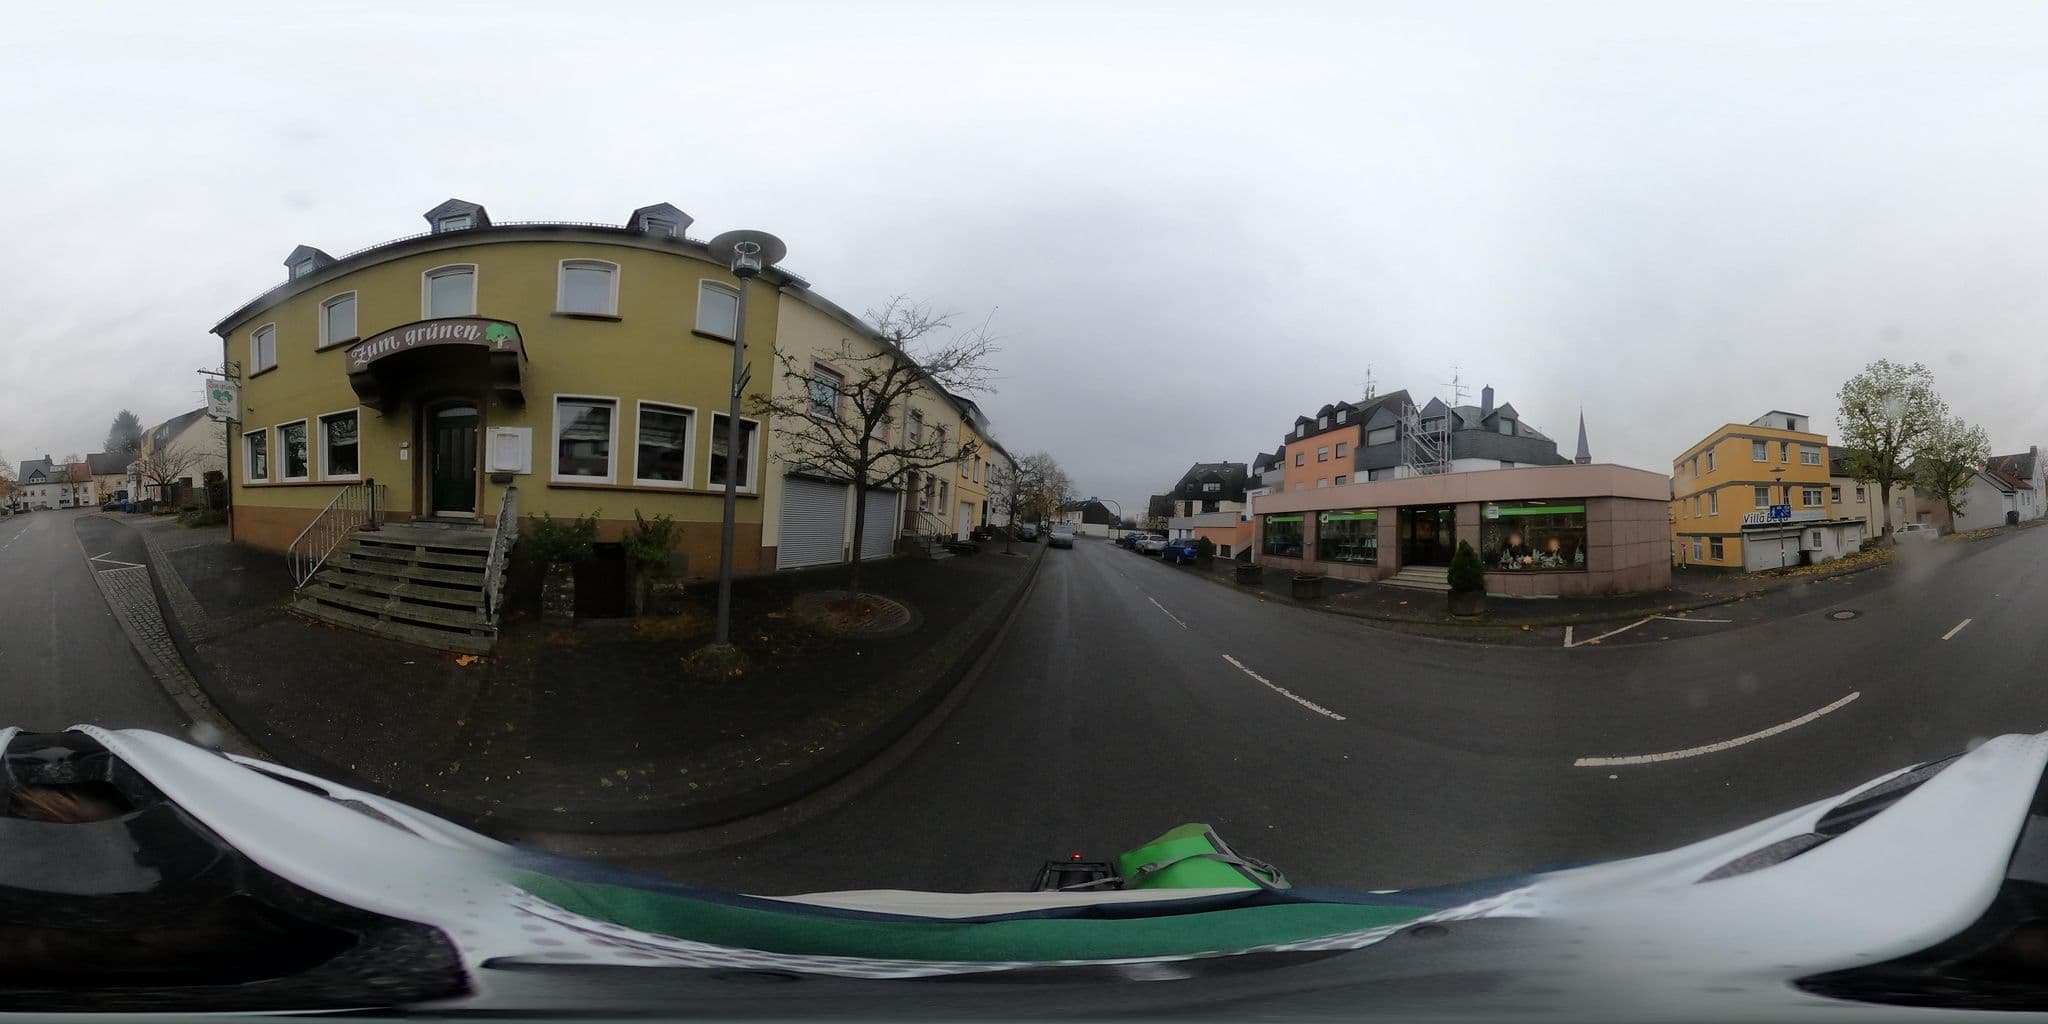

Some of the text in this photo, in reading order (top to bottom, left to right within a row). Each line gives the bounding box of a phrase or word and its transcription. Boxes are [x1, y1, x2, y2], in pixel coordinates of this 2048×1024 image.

[351, 322, 482, 366] Zum grünen
[1744, 512, 1765, 523] Villa
